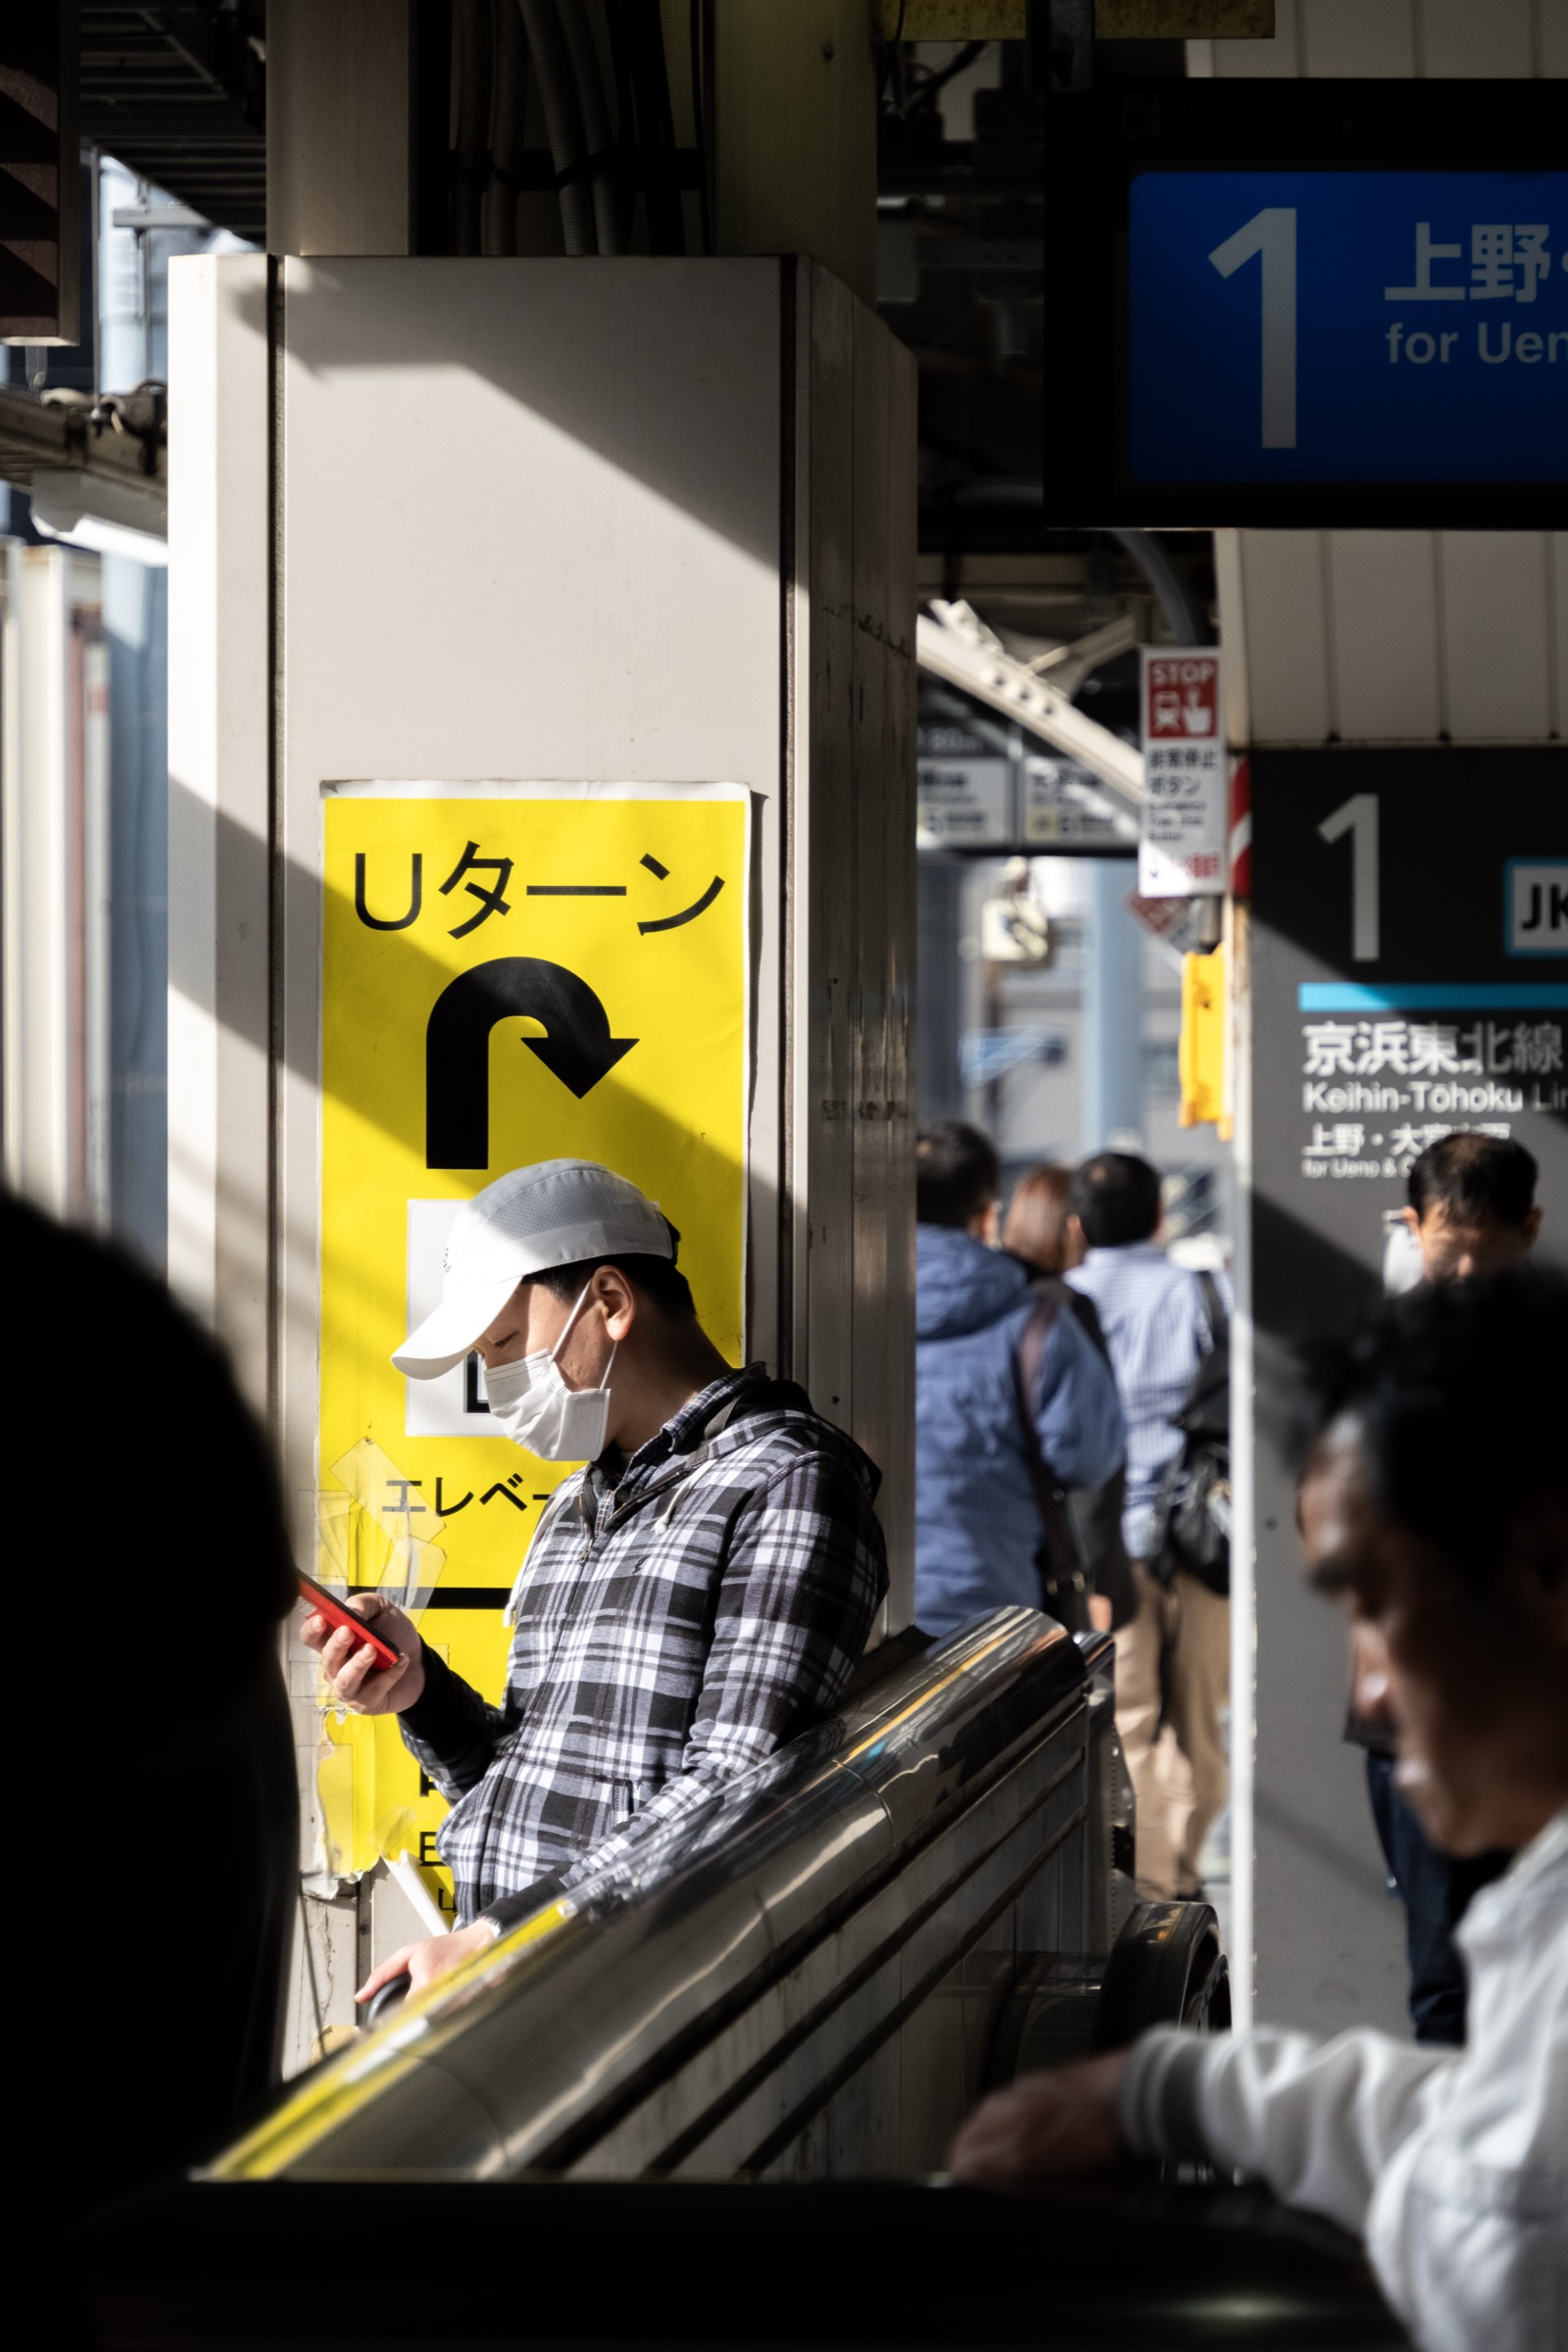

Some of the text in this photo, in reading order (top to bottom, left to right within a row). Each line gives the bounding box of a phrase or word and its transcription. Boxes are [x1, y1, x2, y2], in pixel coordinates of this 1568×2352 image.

[1207, 208, 1297, 449] 1
[1386, 323, 1459, 364] for
[1153, 662, 1215, 684] STOP
[355, 840, 725, 939] Uターン
[1316, 793, 1380, 961] 1
[1302, 1021, 1564, 1076] 京浜東北線
